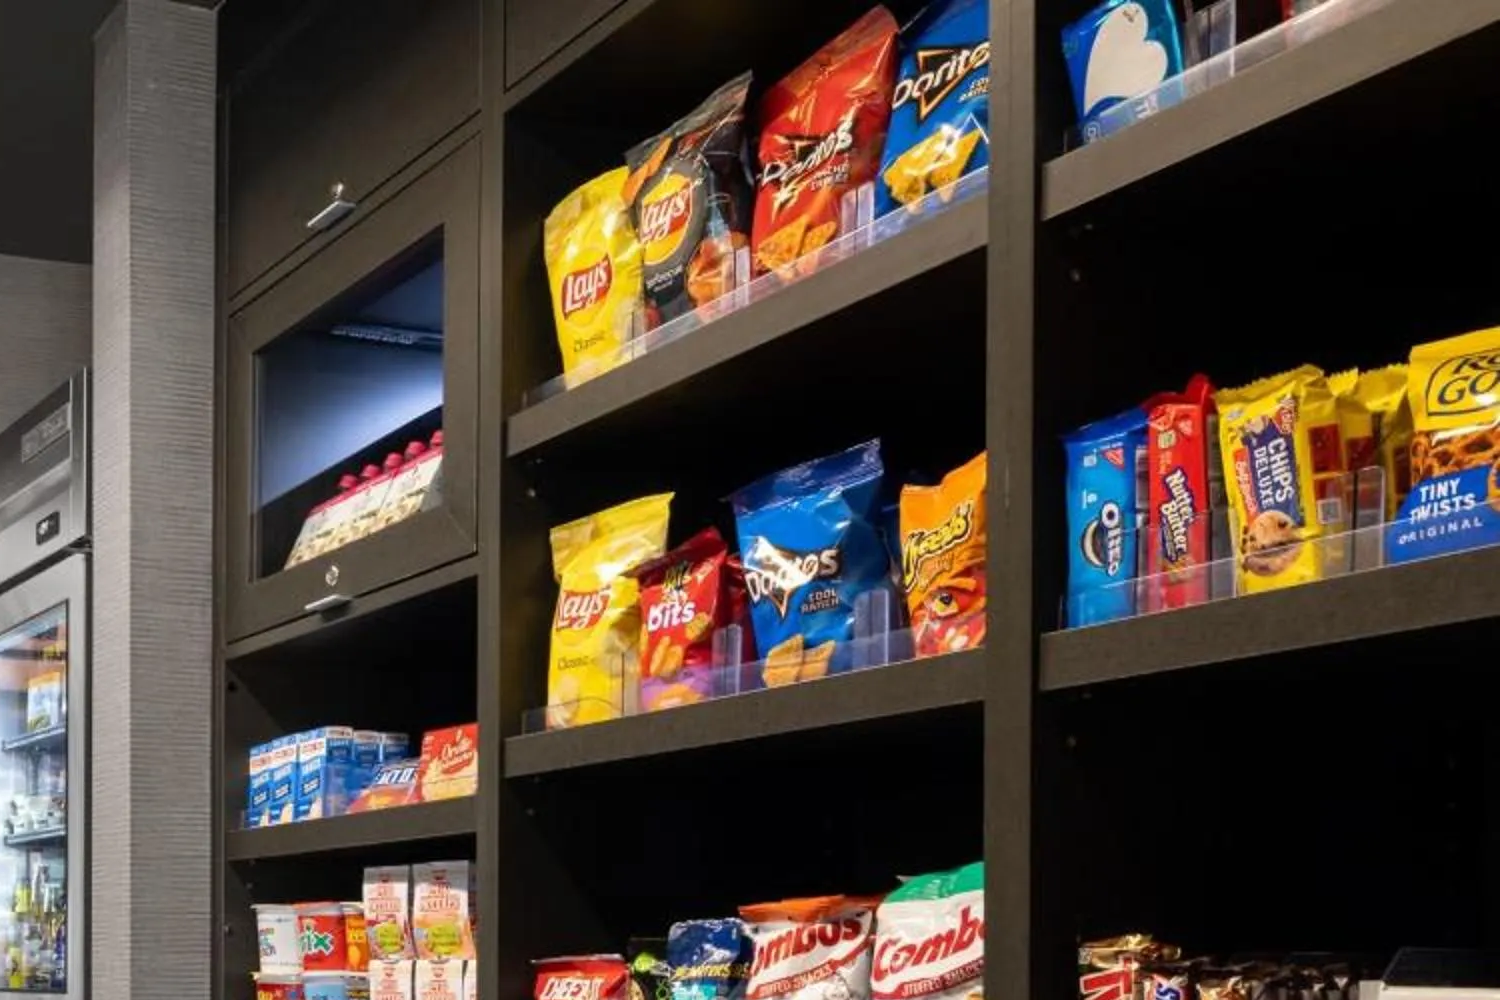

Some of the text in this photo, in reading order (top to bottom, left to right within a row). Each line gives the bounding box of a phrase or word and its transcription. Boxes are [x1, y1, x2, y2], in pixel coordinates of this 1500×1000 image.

[1253, 445, 1275, 510] DELUXE
[1267, 437, 1295, 503] CHIPS
[1419, 477, 1461, 502] TINY
[1398, 516, 1484, 545] ORIGINAL
[1409, 493, 1476, 525] TWISTS
[744, 549, 838, 604] Doos
[751, 919, 862, 979] mbos
